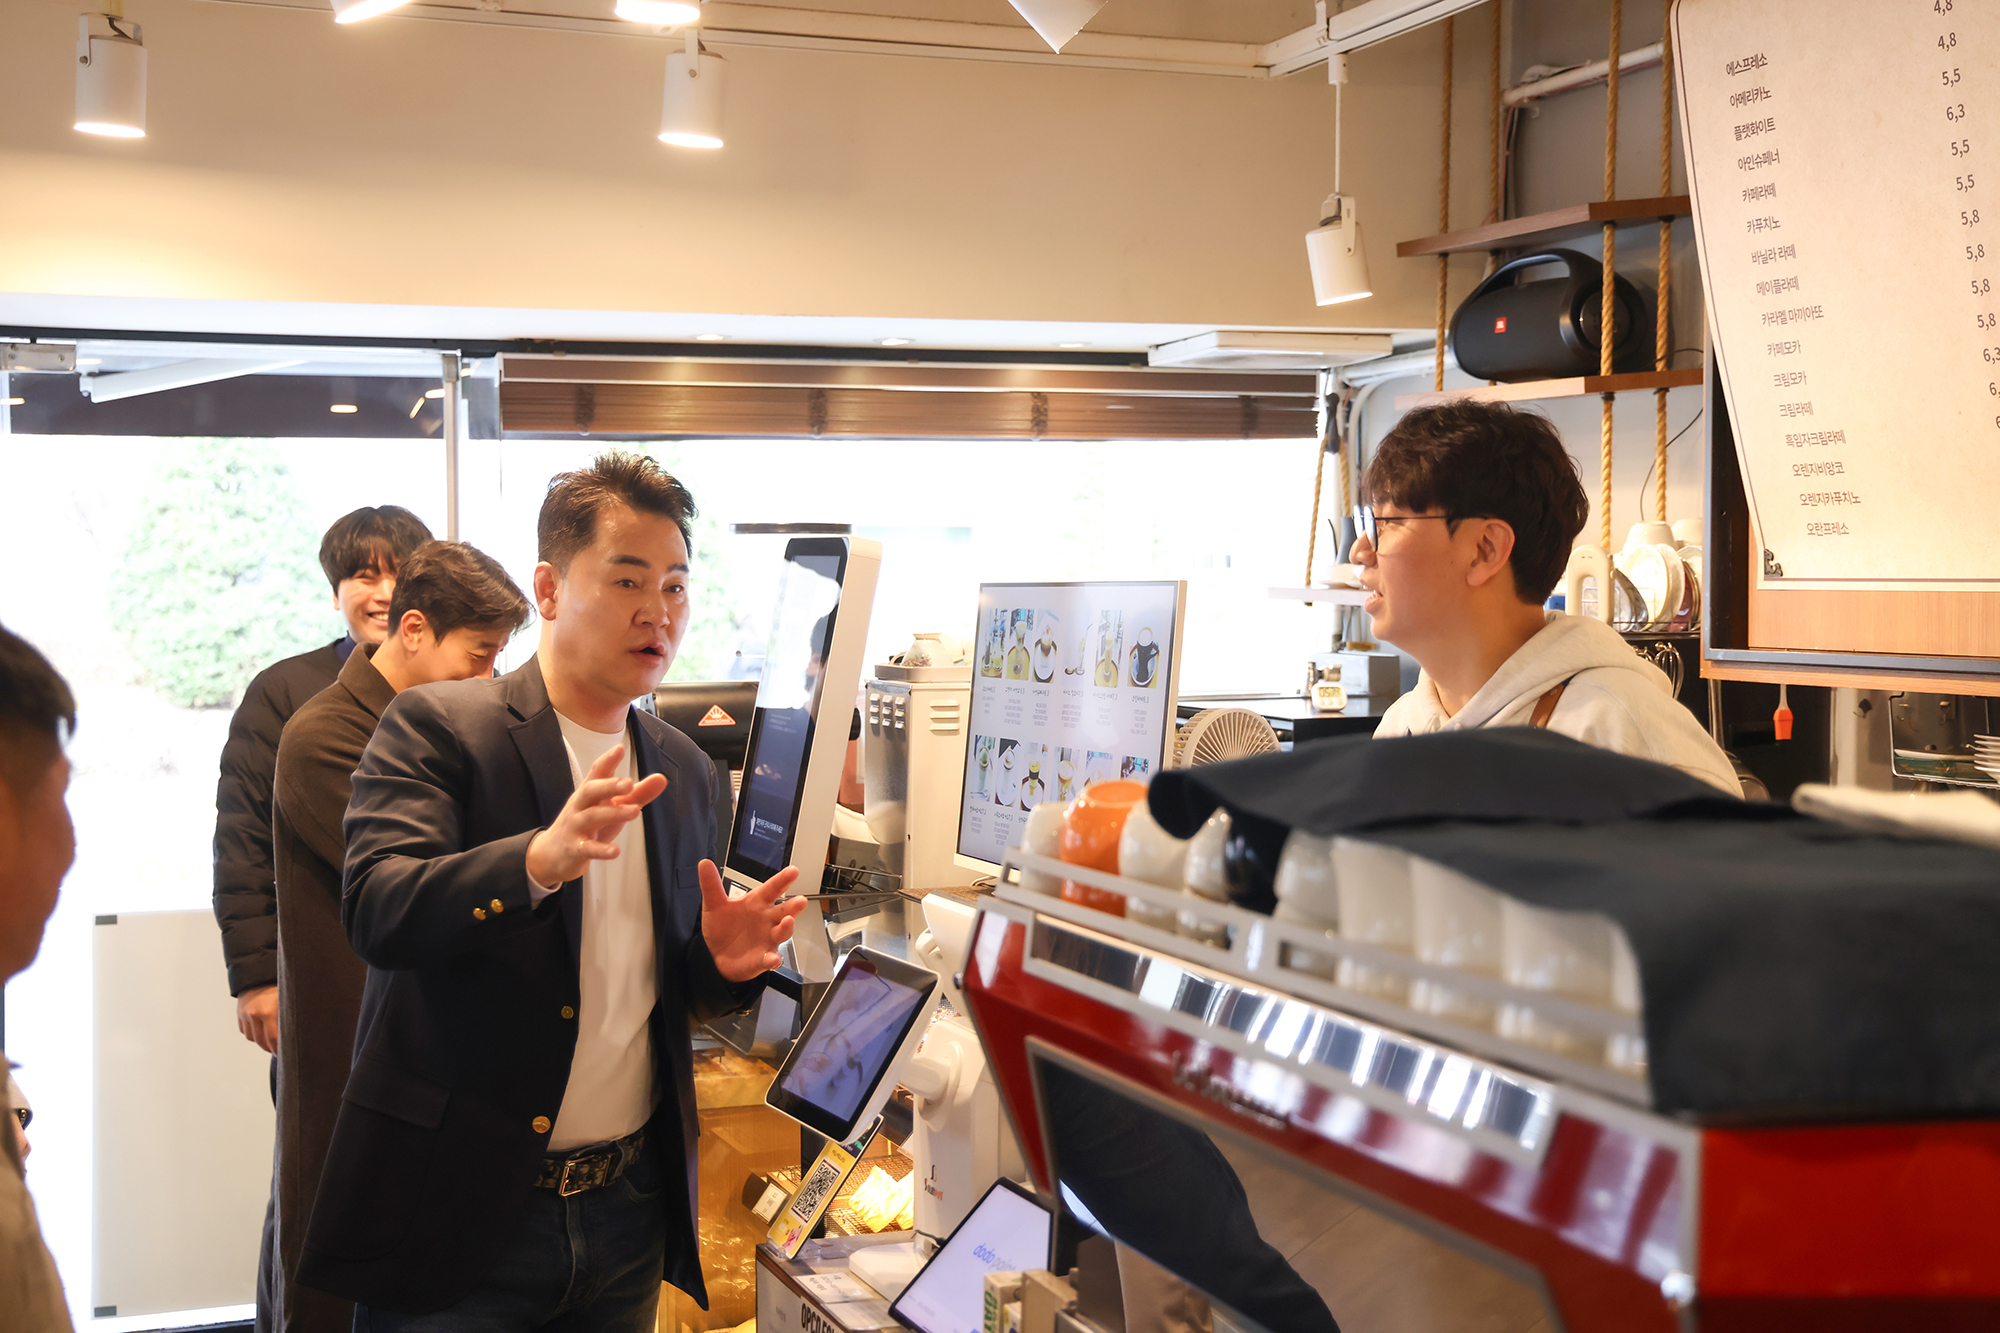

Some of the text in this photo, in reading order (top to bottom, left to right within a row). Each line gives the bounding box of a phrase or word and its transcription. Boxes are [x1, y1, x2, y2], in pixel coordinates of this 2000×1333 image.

[1934, 0, 1953, 16] 4,8
[1938, 32, 1956, 52] 4,8
[1726, 53, 1768, 76] 에스프레소
[1942, 68, 1960, 87] 5,5
[1730, 87, 1772, 108] 아메리카노
[1947, 104, 1965, 122] 6,3
[1734, 117, 1776, 141] 플랫화이트
[1951, 139, 1969, 158] 5,5
[1738, 148, 1780, 171] 아인슈페너
[1742, 183, 1776, 202] 카페라떼
[1956, 174, 1974, 193] 5,5
[1747, 216, 1781, 234] 카푸치노
[1961, 209, 1979, 227] 5,8
[1751, 244, 1796, 265] 바닐라 라떼
[1966, 244, 1985, 262] 5,8
[1756, 276, 1799, 295] 메이플라떼
[1971, 279, 1990, 296] 5,8
[1762, 305, 1824, 326] 카라멜 마끼아또
[1977, 313, 1996, 330] 5,8
[1767, 340, 1801, 357] 카페모카
[1774, 371, 1807, 387] 크림모카
[1780, 402, 1813, 417] 크림라떼
[1792, 461, 1845, 477] 오렌지비앙코
[1800, 491, 1861, 506] 오렌지카푸치노
[1807, 522, 1849, 536] 오란프레소
[973, 1242, 996, 1264] dodo
